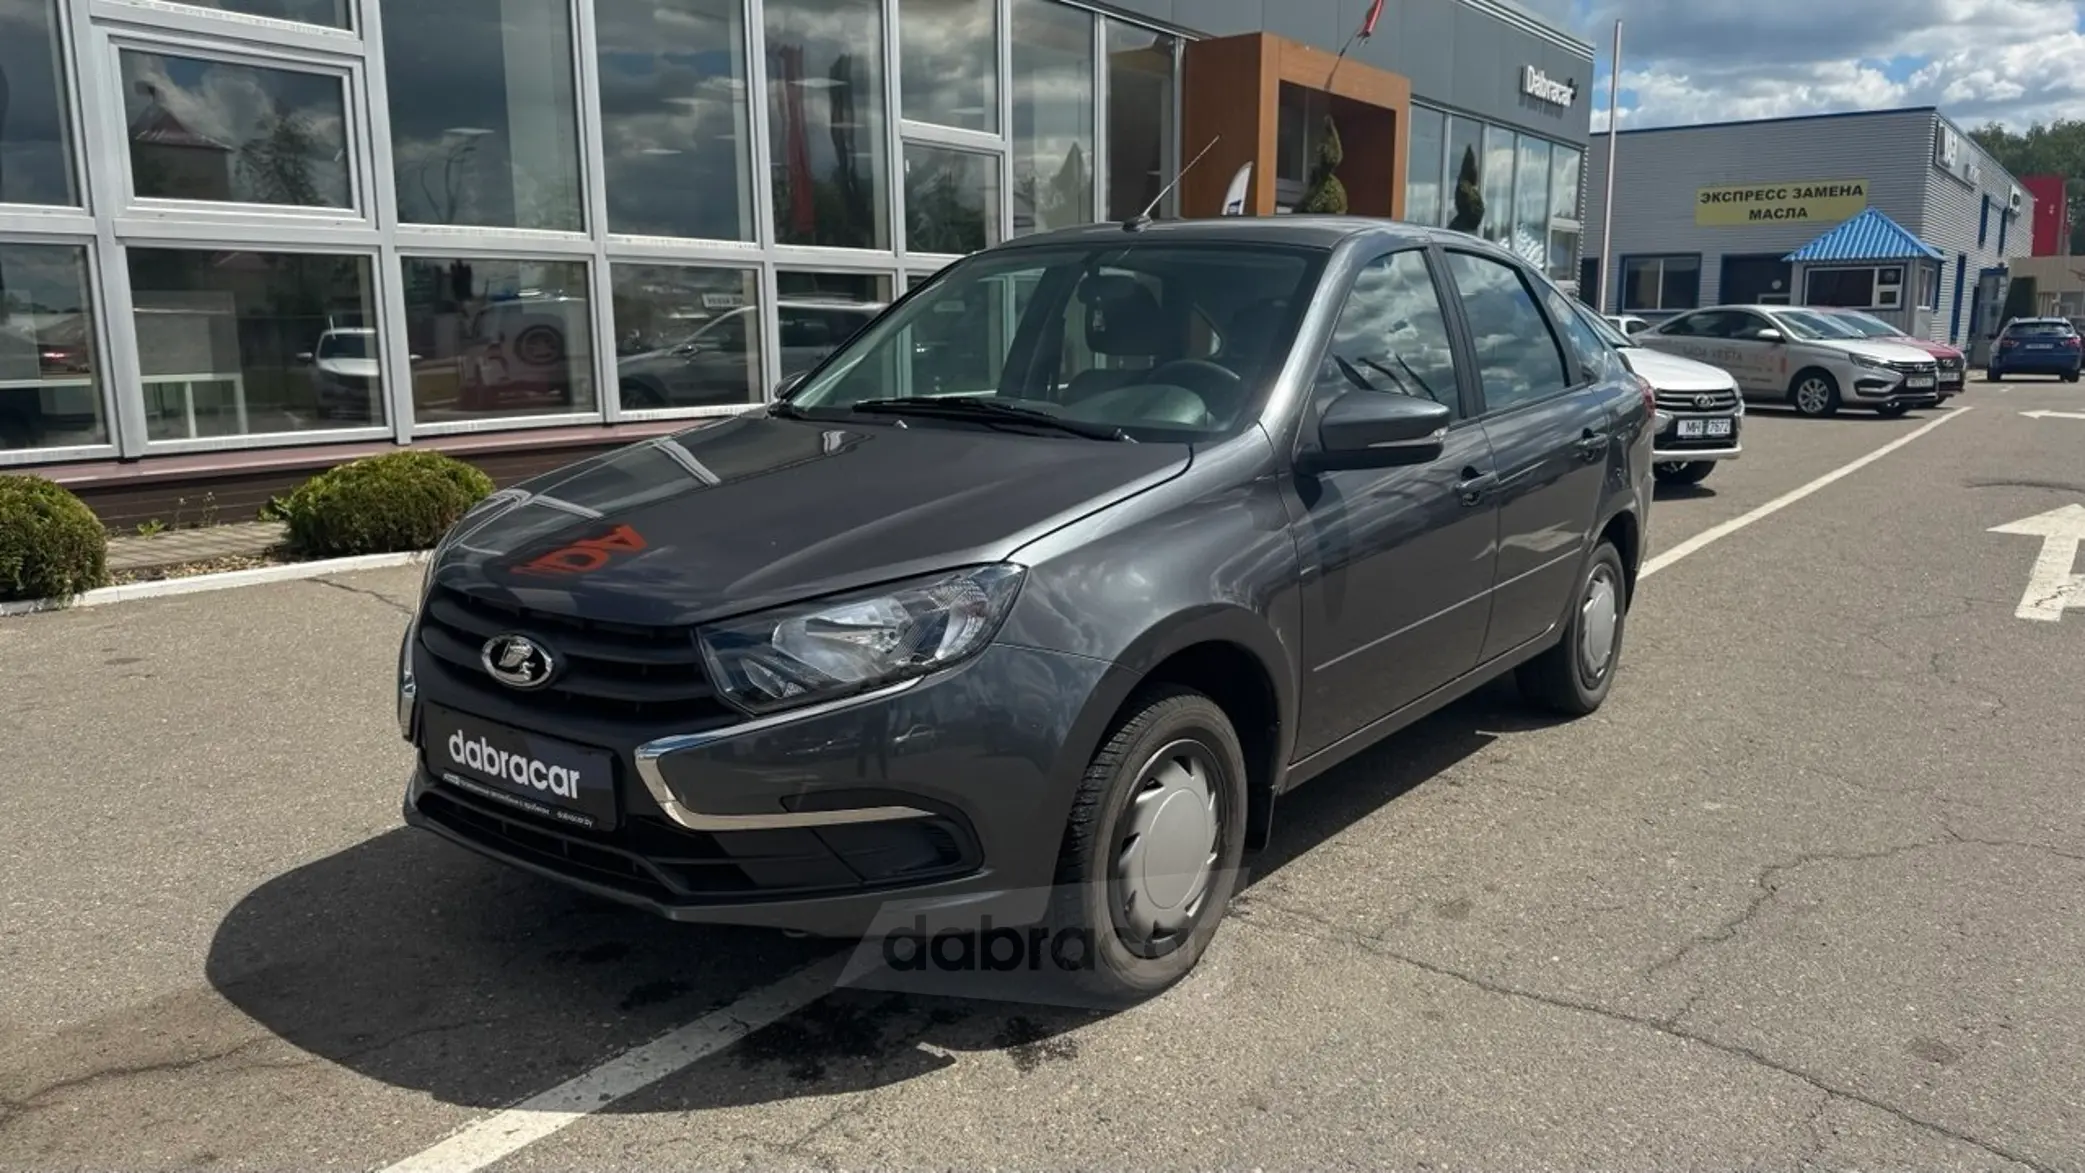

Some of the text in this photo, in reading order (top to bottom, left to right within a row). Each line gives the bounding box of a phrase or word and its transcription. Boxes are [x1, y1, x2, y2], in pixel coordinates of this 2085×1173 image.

[1700, 185, 1863, 203] ЭКСПРЕСС ЗАМЕНА
[1749, 207, 1808, 220] МАСЛА
[449, 730, 580, 798] dabracar
